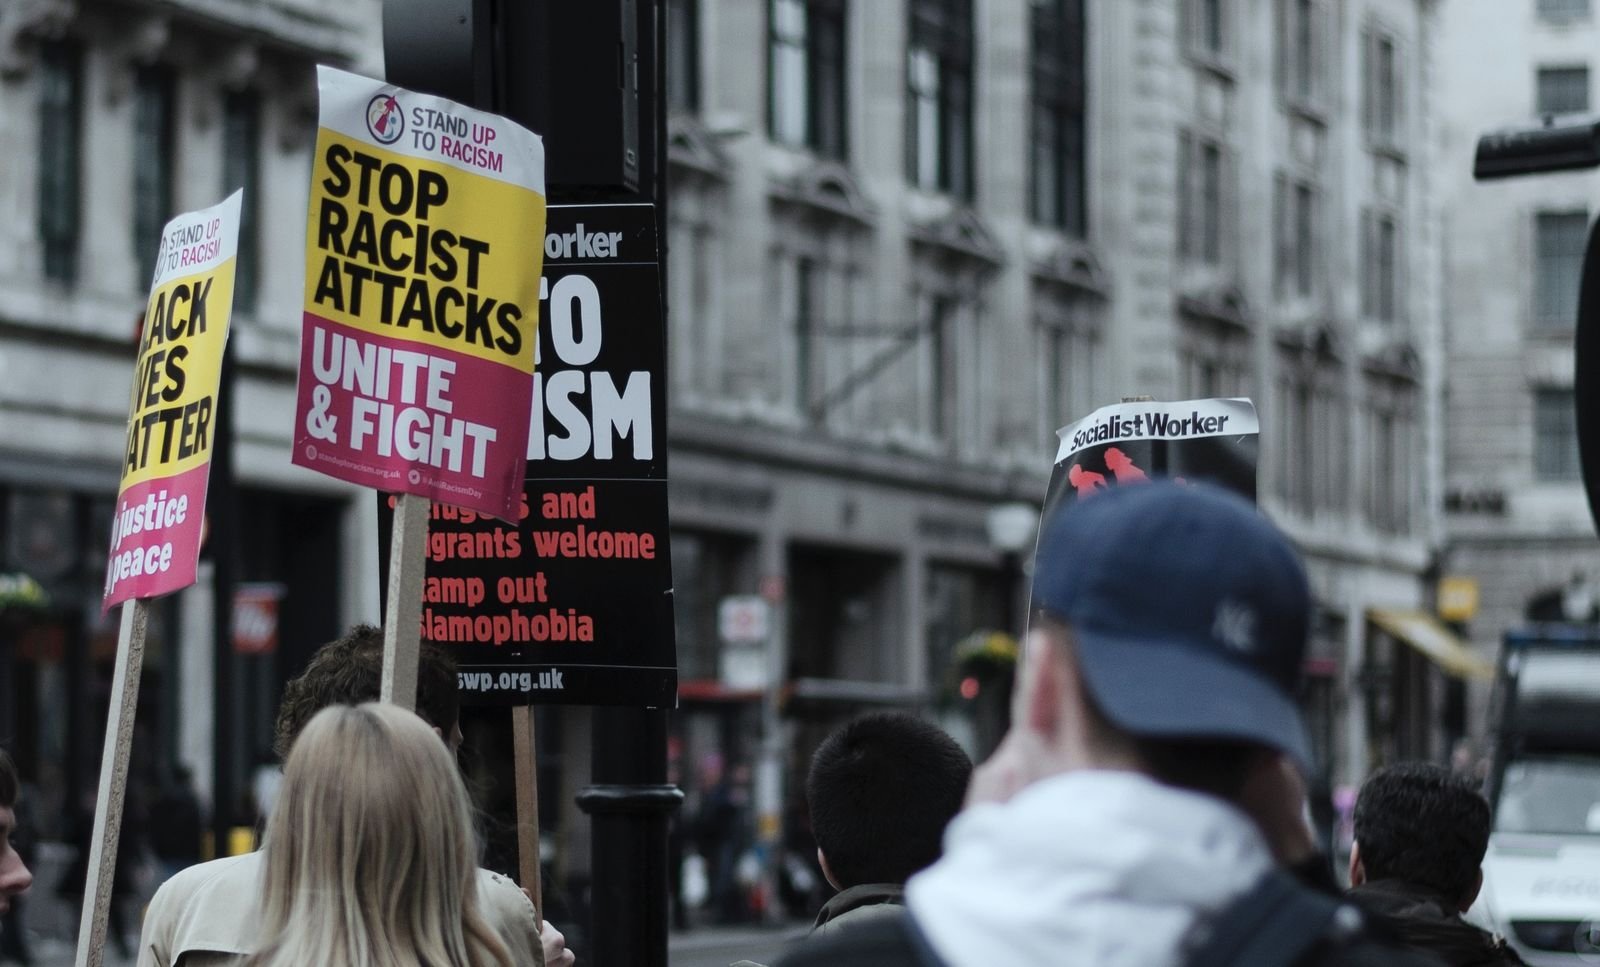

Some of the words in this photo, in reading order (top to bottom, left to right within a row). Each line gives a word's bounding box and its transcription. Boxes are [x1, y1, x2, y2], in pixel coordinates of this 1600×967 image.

[411, 107, 468, 138] STAND
[472, 123, 496, 147] UP
[411, 129, 436, 152] TO
[440, 135, 503, 173] RACISM
[322, 143, 449, 220] STOP
[167, 252, 179, 273] TO
[180, 237, 221, 268] RACISM
[169, 223, 204, 250] STAND
[206, 218, 220, 240] UP
[318, 197, 490, 290] RACIST
[544, 223, 623, 259] orker
[313, 255, 523, 356] ATTACKS
[312, 327, 457, 414] UNITE
[122, 395, 212, 479] ATTER
[305, 384, 338, 444] &
[350, 396, 497, 479] FIGHT
[527, 370, 653, 460] ISM
[116, 490, 188, 551] justice
[542, 485, 596, 519] and
[111, 542, 173, 595] peace
[425, 527, 521, 561] igrants
[533, 525, 655, 559] welcome
[497, 572, 548, 603] out
